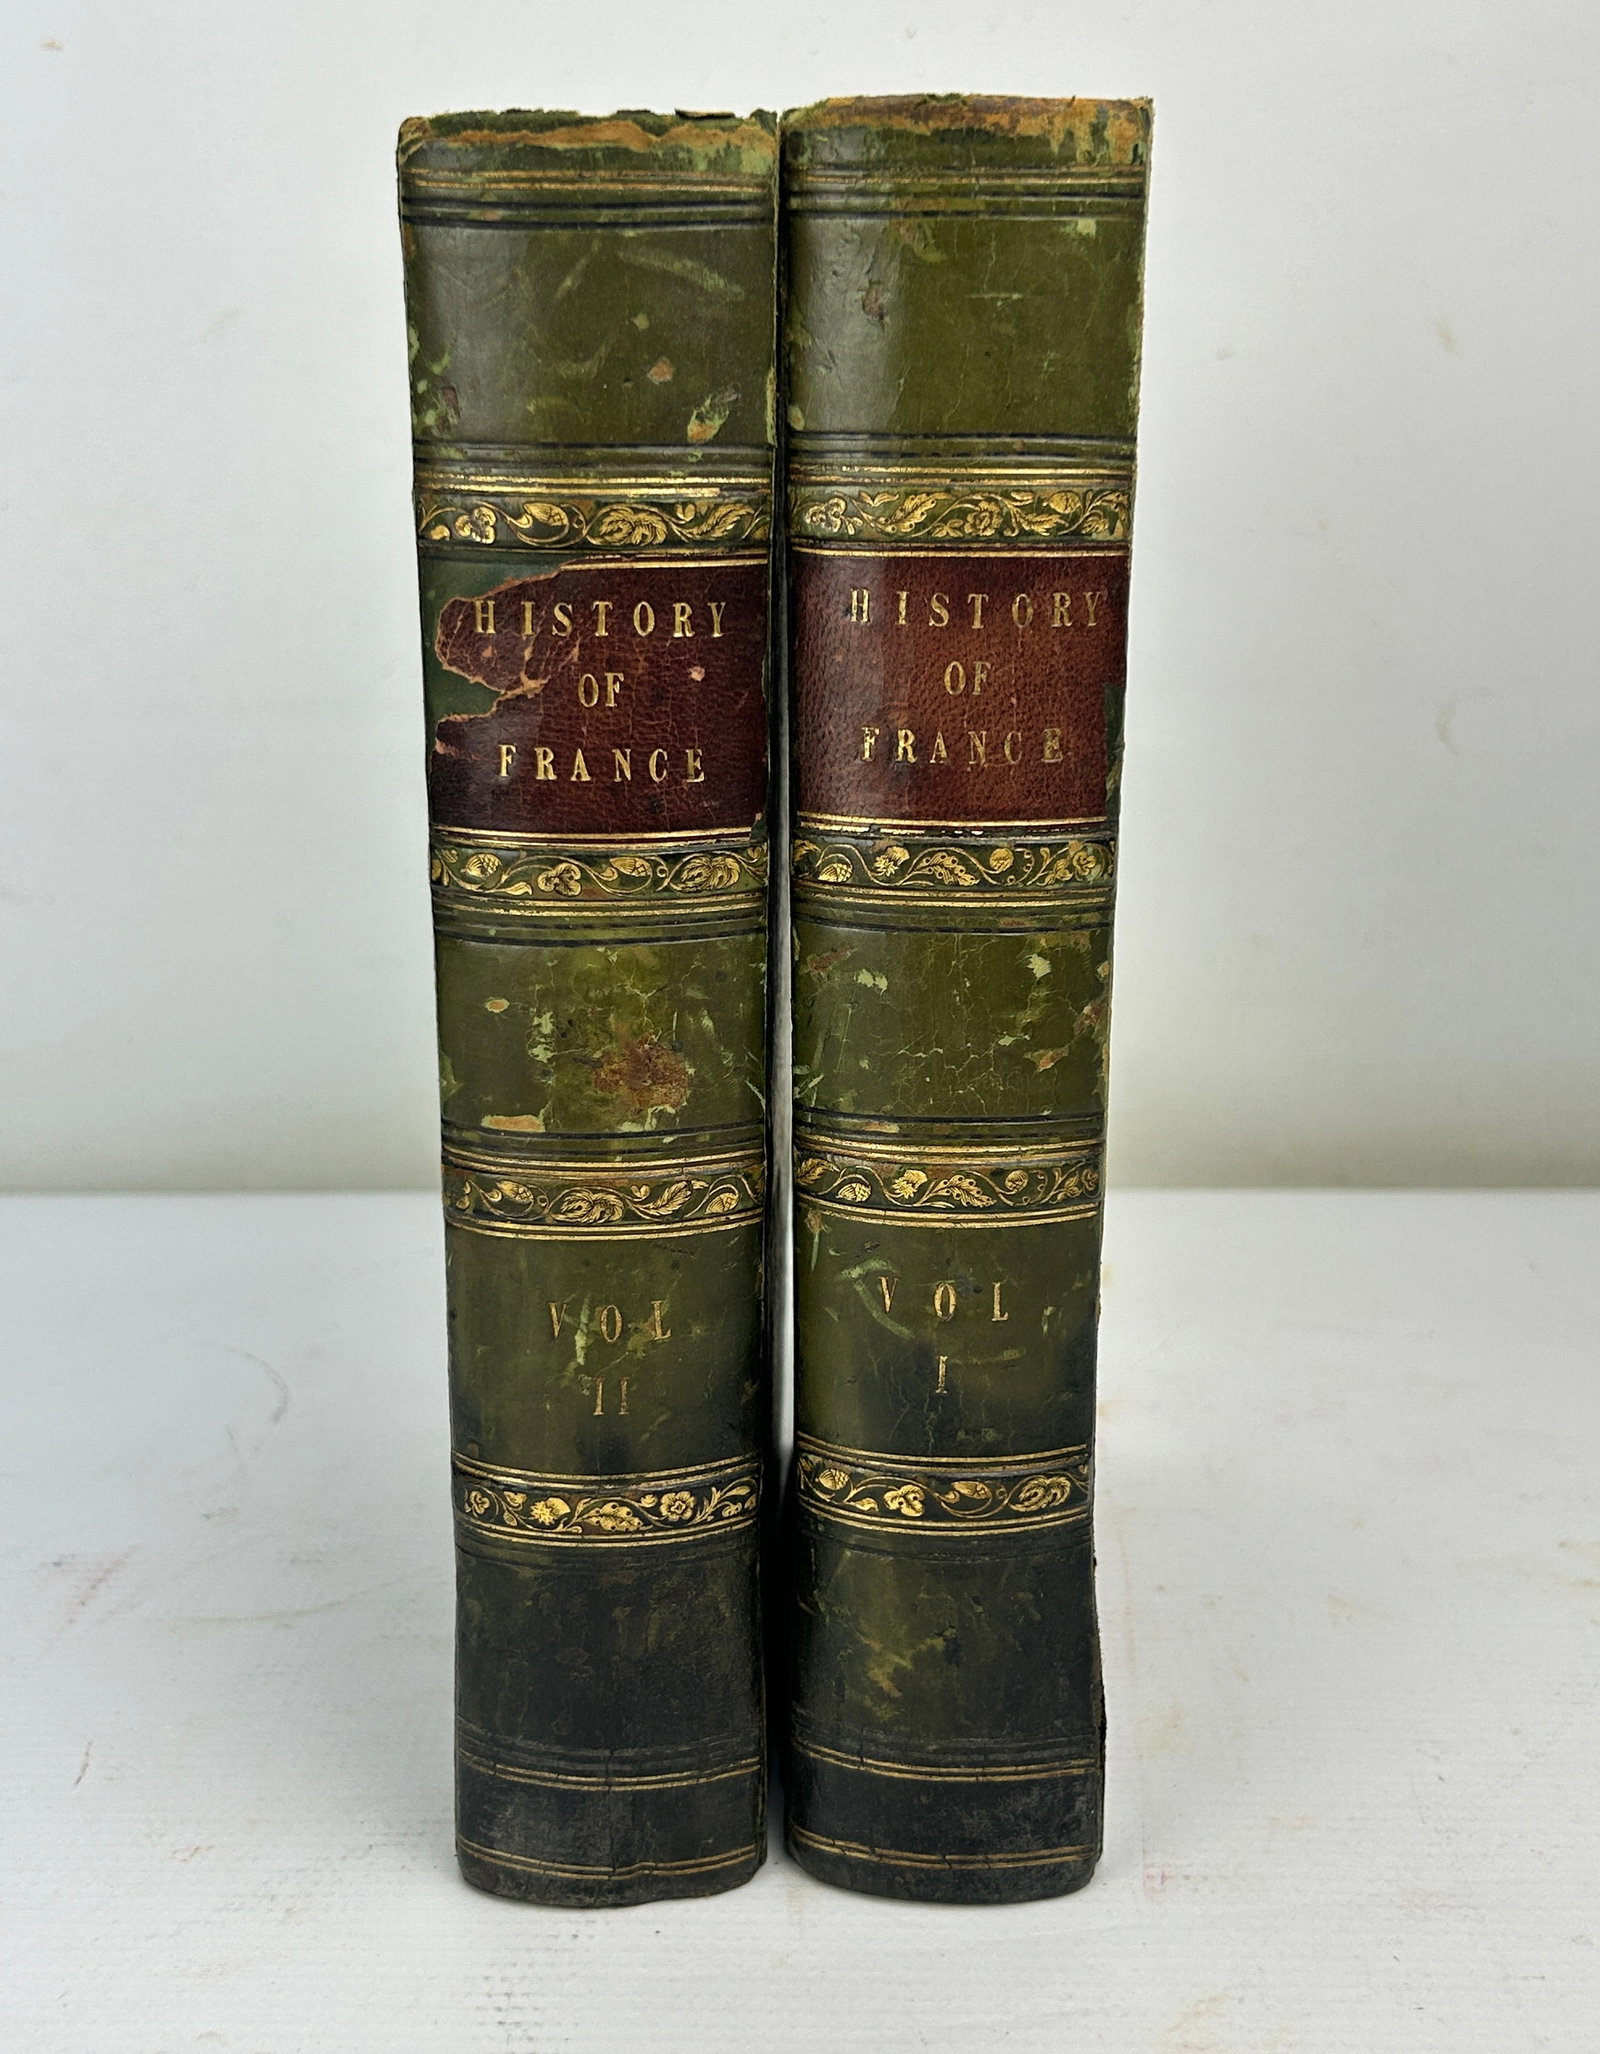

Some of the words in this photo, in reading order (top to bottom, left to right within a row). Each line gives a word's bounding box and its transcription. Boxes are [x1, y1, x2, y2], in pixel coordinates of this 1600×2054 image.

[473, 600, 726, 638] HISTORY
[849, 588, 1103, 629] HISTORY
[577, 672, 625, 708] OF
[943, 660, 992, 696] OF
[498, 744, 706, 783] FRANCE
[859, 726, 1064, 765] FRANCE
[878, 1275, 1009, 1322] VOL
[548, 1300, 672, 1343] VOL
[935, 1355, 949, 1394] I
[593, 1376, 630, 1416] II
